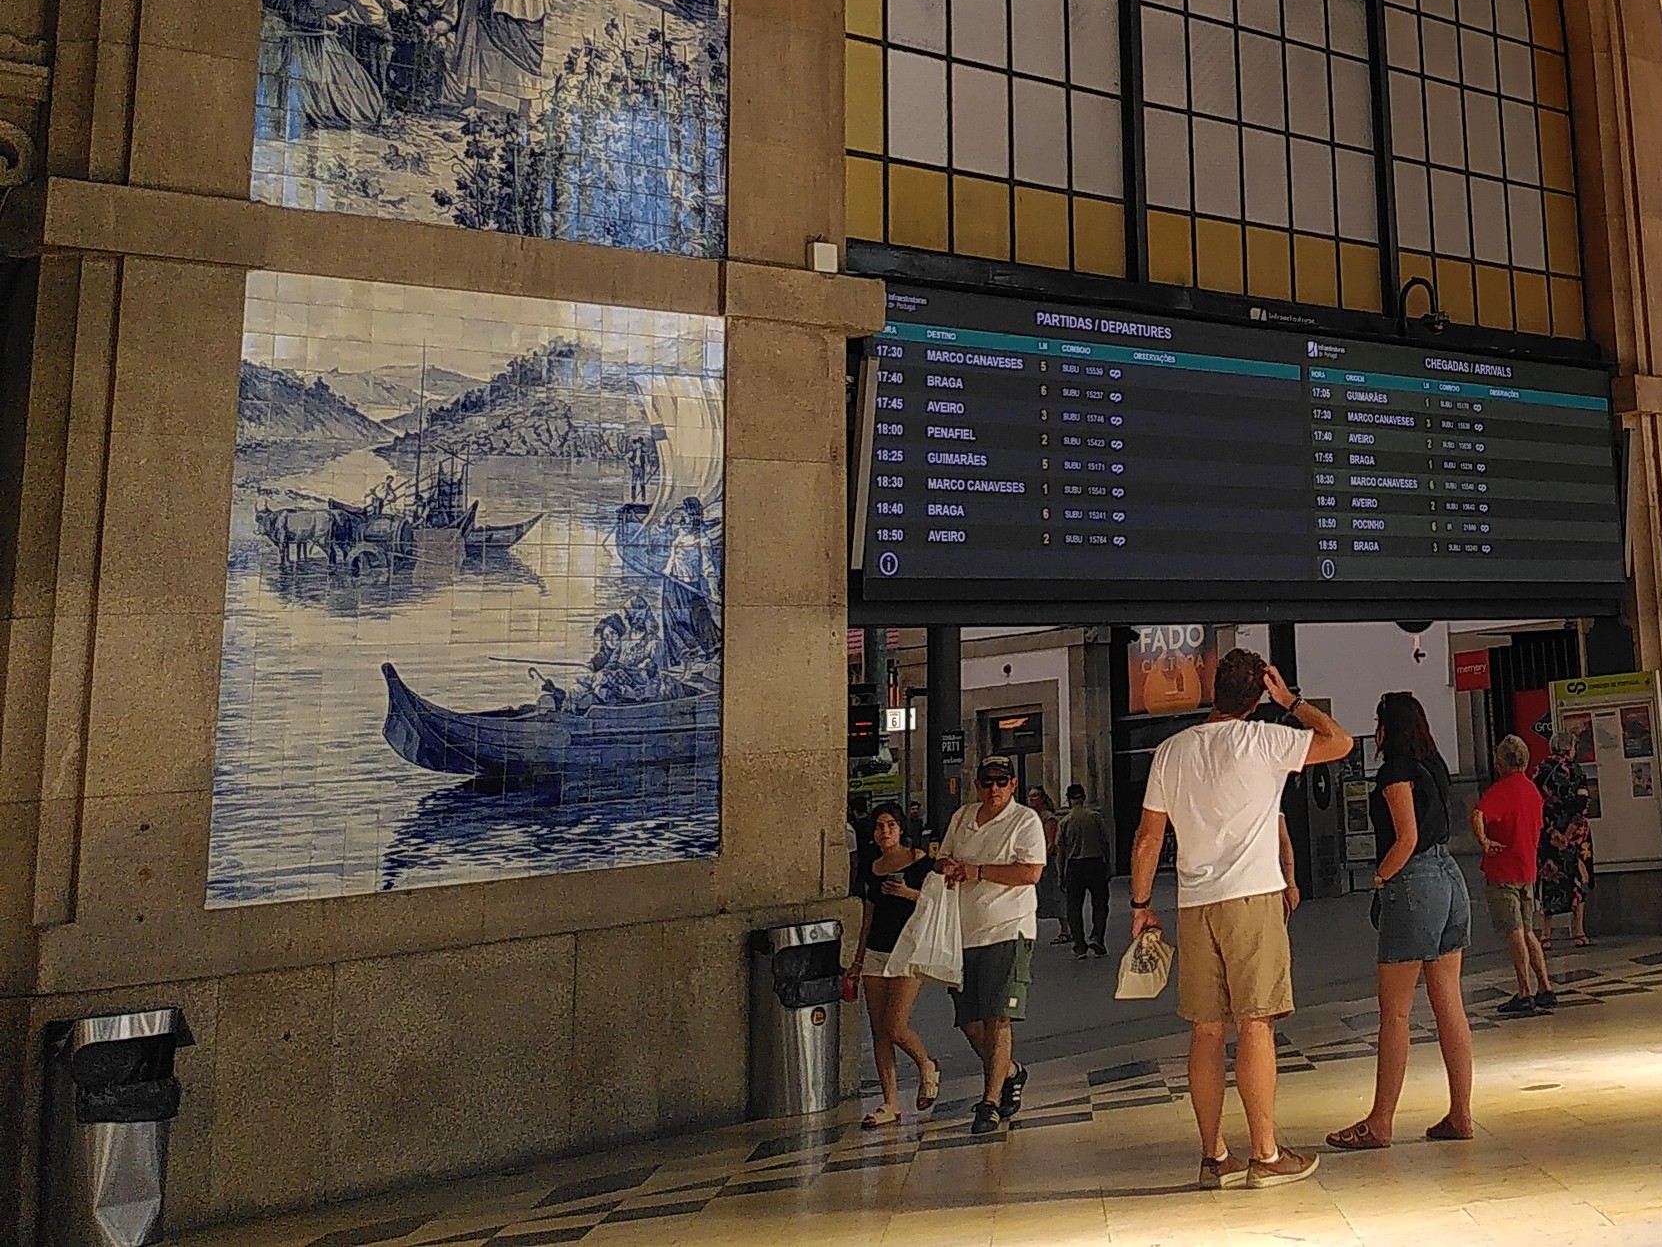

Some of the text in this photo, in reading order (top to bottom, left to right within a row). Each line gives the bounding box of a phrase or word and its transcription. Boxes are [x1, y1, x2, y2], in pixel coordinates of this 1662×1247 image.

[1037, 312, 1172, 339] PARTIDAS / DEPARTURES
[927, 330, 957, 340] DESTINO
[1062, 344, 1091, 354] COMBOIO
[1134, 352, 1176, 364] OBSERVAÇÕES
[877, 345, 903, 357] 17:30
[927, 350, 964, 364] MARCO
[966, 354, 1023, 369] CANAVESES
[1041, 362, 1047, 372] 5
[1062, 364, 1080, 373] SUBU
[1425, 358, 1469, 373] CHEGADAS
[1475, 363, 1512, 378] ARRIVALS
[877, 371, 903, 383] 17:40
[927, 376, 964, 388] BRAGA
[1041, 386, 1047, 396] 6
[1063, 388, 1080, 397] SUBU
[1312, 388, 1331, 399] 17:05
[1347, 391, 1388, 404] GUIMARÃES
[877, 397, 903, 409] 17:45
[927, 401, 965, 414] AVEIRO
[1041, 410, 1048, 421] 3
[1063, 413, 1081, 421] SUBU
[1313, 409, 1332, 420] 17:30
[1348, 412, 1374, 423] MARCO
[1375, 414, 1415, 426] CANAVESES
[877, 424, 903, 435] 18:00
[927, 426, 976, 440] PENAFIEL
[1042, 434, 1048, 445] 2
[1063, 437, 1081, 445] SUBU
[1314, 431, 1333, 441] 17:40
[1349, 434, 1375, 444] AVEIRO
[1427, 439, 1432, 449] 2
[877, 450, 903, 461] 18:25
[928, 452, 987, 466] GUIMARÃES
[1042, 459, 1048, 470] 5
[1064, 461, 1082, 470] SUBU
[1315, 453, 1334, 463] 17:55
[1350, 455, 1375, 465] BRAGA
[1429, 459, 1433, 470] 1
[877, 476, 903, 488] 18:30
[928, 478, 965, 490] MARCO
[967, 480, 1025, 493] CANAVESES
[1043, 484, 1048, 495] 1
[1064, 486, 1082, 494] SUBU
[1316, 475, 1335, 485] 18:30
[1351, 476, 1376, 486] MARCO
[1378, 478, 1418, 489] CANAVESES
[877, 503, 903, 514] 18:40
[928, 504, 965, 516] BRAGA
[1043, 509, 1049, 520] 6
[1065, 510, 1083, 519] SUBU
[1317, 497, 1336, 507] 18:40
[1352, 498, 1378, 508] AVEIRO
[1431, 501, 1436, 511] 2
[1318, 518, 1337, 528] 18:50
[1353, 520, 1385, 529] POCINHO
[1432, 522, 1437, 531] 6
[877, 529, 903, 541] 18:50
[928, 530, 966, 542] AVEIRO
[1043, 534, 1050, 545] 2
[1066, 535, 1083, 543] SUBU
[1319, 540, 1337, 550] 18:55
[1354, 541, 1379, 551] BRAGA
[1433, 543, 1438, 552] 3
[1140, 624, 1205, 653] FADO
[1457, 664, 1487, 674] memory
[892, 717, 898, 727] 6
